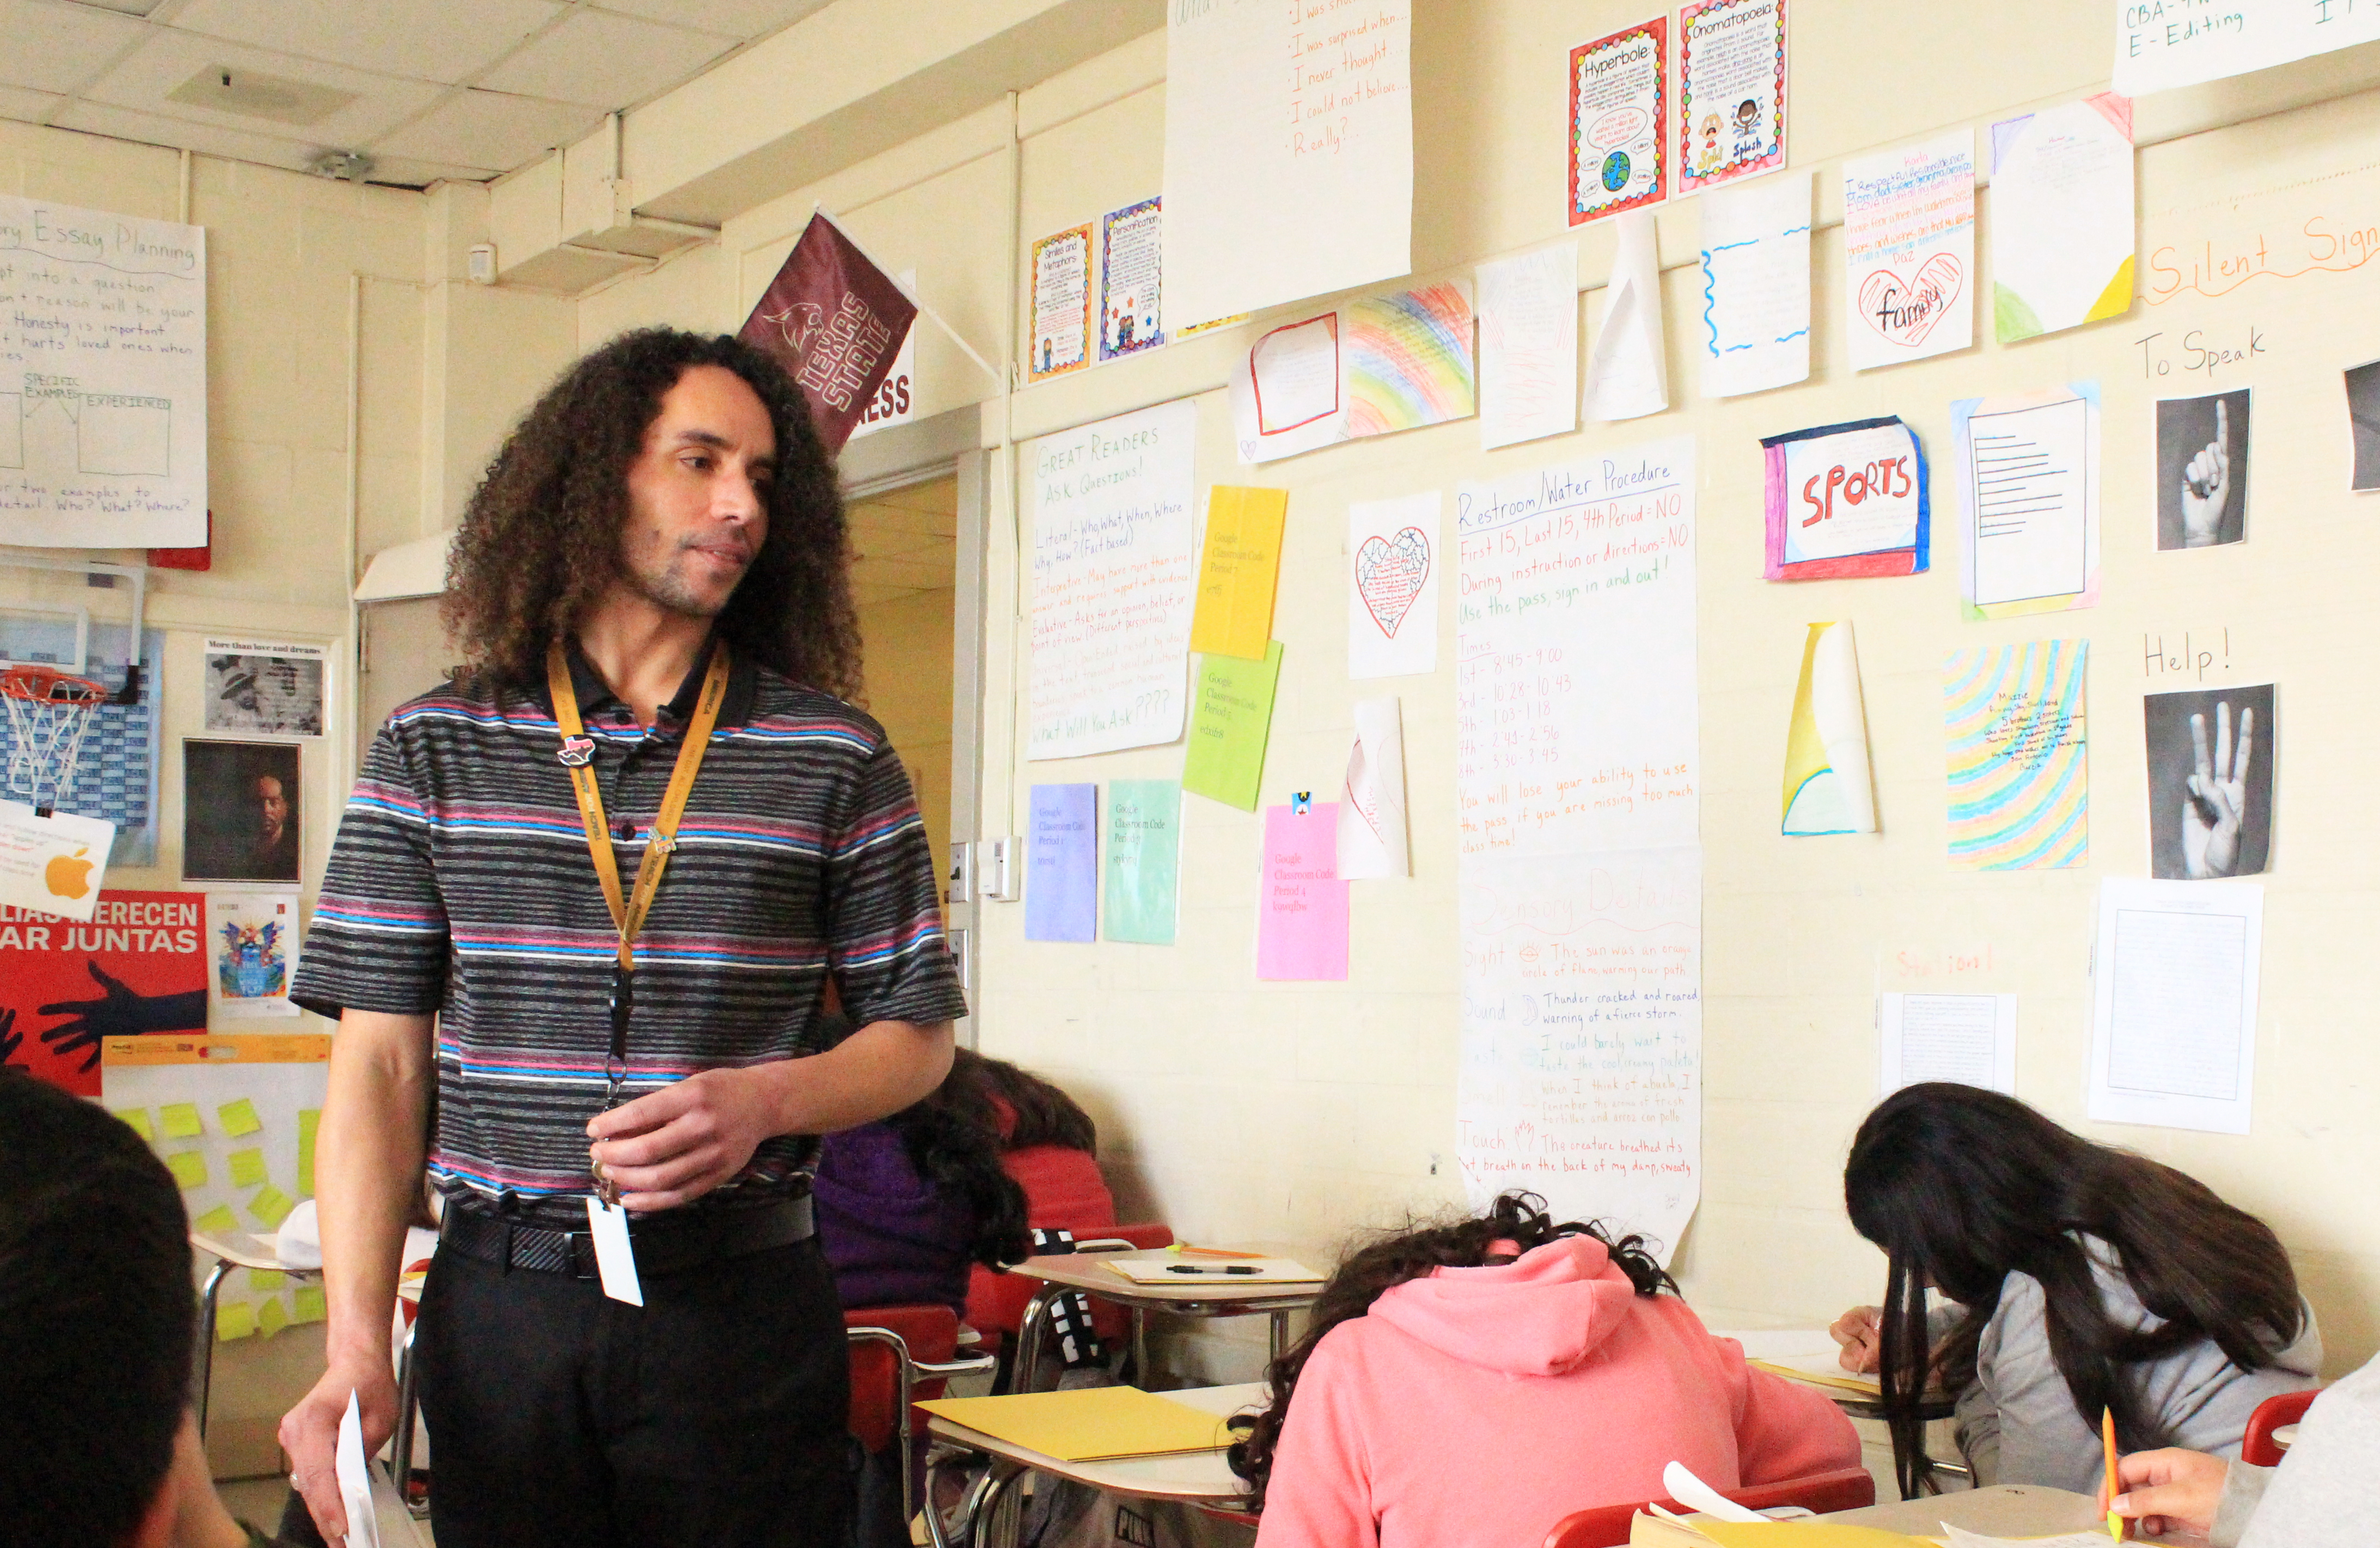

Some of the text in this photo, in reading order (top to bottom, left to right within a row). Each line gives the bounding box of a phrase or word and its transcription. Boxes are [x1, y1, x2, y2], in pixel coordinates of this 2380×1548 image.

[1291, 33, 1304, 58] I
[1307, 40, 1323, 52] was
[1329, 19, 1367, 46] surprised
[2167, 13, 2243, 46] Editing
[1585, 45, 1650, 78] Hyperbole:
[1292, 65, 1304, 92] I
[1309, 68, 1335, 85] never
[1291, 101, 1302, 124] I
[1307, 93, 1334, 118] could
[1341, 81, 1360, 107] not
[1733, 137, 1762, 163] Splash
[1905, 152, 1928, 166] Karla
[34, 210, 196, 270] Essay Planning
[1045, 241, 1077, 259] Similes and
[2151, 234, 2268, 293] Silent
[27, 269, 155, 296] into question
[36, 294, 194, 323] reason will your
[1876, 285, 1943, 331] family
[14, 312, 166, 338] Honesty important
[22, 336, 192, 355] hurts loved ones when
[796, 292, 869, 392] TEXAS
[2134, 326, 2265, 379] To Speak
[822, 315, 891, 413] STATE
[23, 373, 78, 386] SPECIFIC
[25, 386, 80, 398] EXAMPLES
[1037, 428, 1158, 478] GREAT READERS
[62, 488, 150, 501] examples to
[1045, 482, 1071, 507] ASK
[1458, 460, 1670, 531] Restroom/Water Procedure
[1802, 455, 1912, 527] SPORTS
[57, 498, 190, 513] Who? What? Where?
[1154, 501, 1182, 517] Where
[1461, 537, 1492, 565] First
[1500, 529, 1521, 557] 15,
[1525, 520, 1551, 546] Last
[1558, 515, 1579, 540] 15,
[1584, 508, 1604, 530] 4th
[1609, 503, 1643, 528] Period
[1113, 577, 1138, 598] support
[1143, 574, 1156, 587] with
[1158, 574, 1188, 587] evidence
[1462, 573, 1502, 595] During
[1512, 554, 1580, 581] instruction
[1586, 554, 1596, 565] or
[1459, 568, 1630, 624] Use the pass, sign in and
[1075, 611, 1094, 626] Asks
[209, 640, 321, 654] More than love and dreams
[1458, 634, 1491, 655] Times
[2145, 627, 2230, 681] Help!
[1205, 702, 1226, 717] Period
[2002, 716, 2007, 726] 5
[2009, 716, 2031, 725] brothers
[1459, 763, 1687, 810] You will lose your ability to use
[1116, 804, 1138, 815] Google
[1461, 783, 1692, 836] the pass if you are missing too much
[1115, 818, 1165, 828] Classroom Code
[1115, 833, 1134, 842] Period
[1463, 837, 1484, 854] class
[1276, 852, 1301, 866] Google
[1275, 869, 1333, 879] Classroom Code
[1274, 885, 1298, 895] Period
[70, 901, 197, 926] ERECEN
[61, 927, 197, 953] JUNTAS
[1551, 943, 1578, 959] The
[1586, 946, 1606, 957] sun
[1543, 989, 1699, 1008] Thunder cracked and roared,
[1543, 1013, 1583, 1031] warning
[1589, 1010, 1599, 1023] of
[1614, 1011, 1640, 1020] fierce
[1595, 1033, 1625, 1053] barely
[1541, 1135, 1682, 1152] The creature breathed its
[1484, 1157, 1691, 1177] breath on the back of my sweaty
